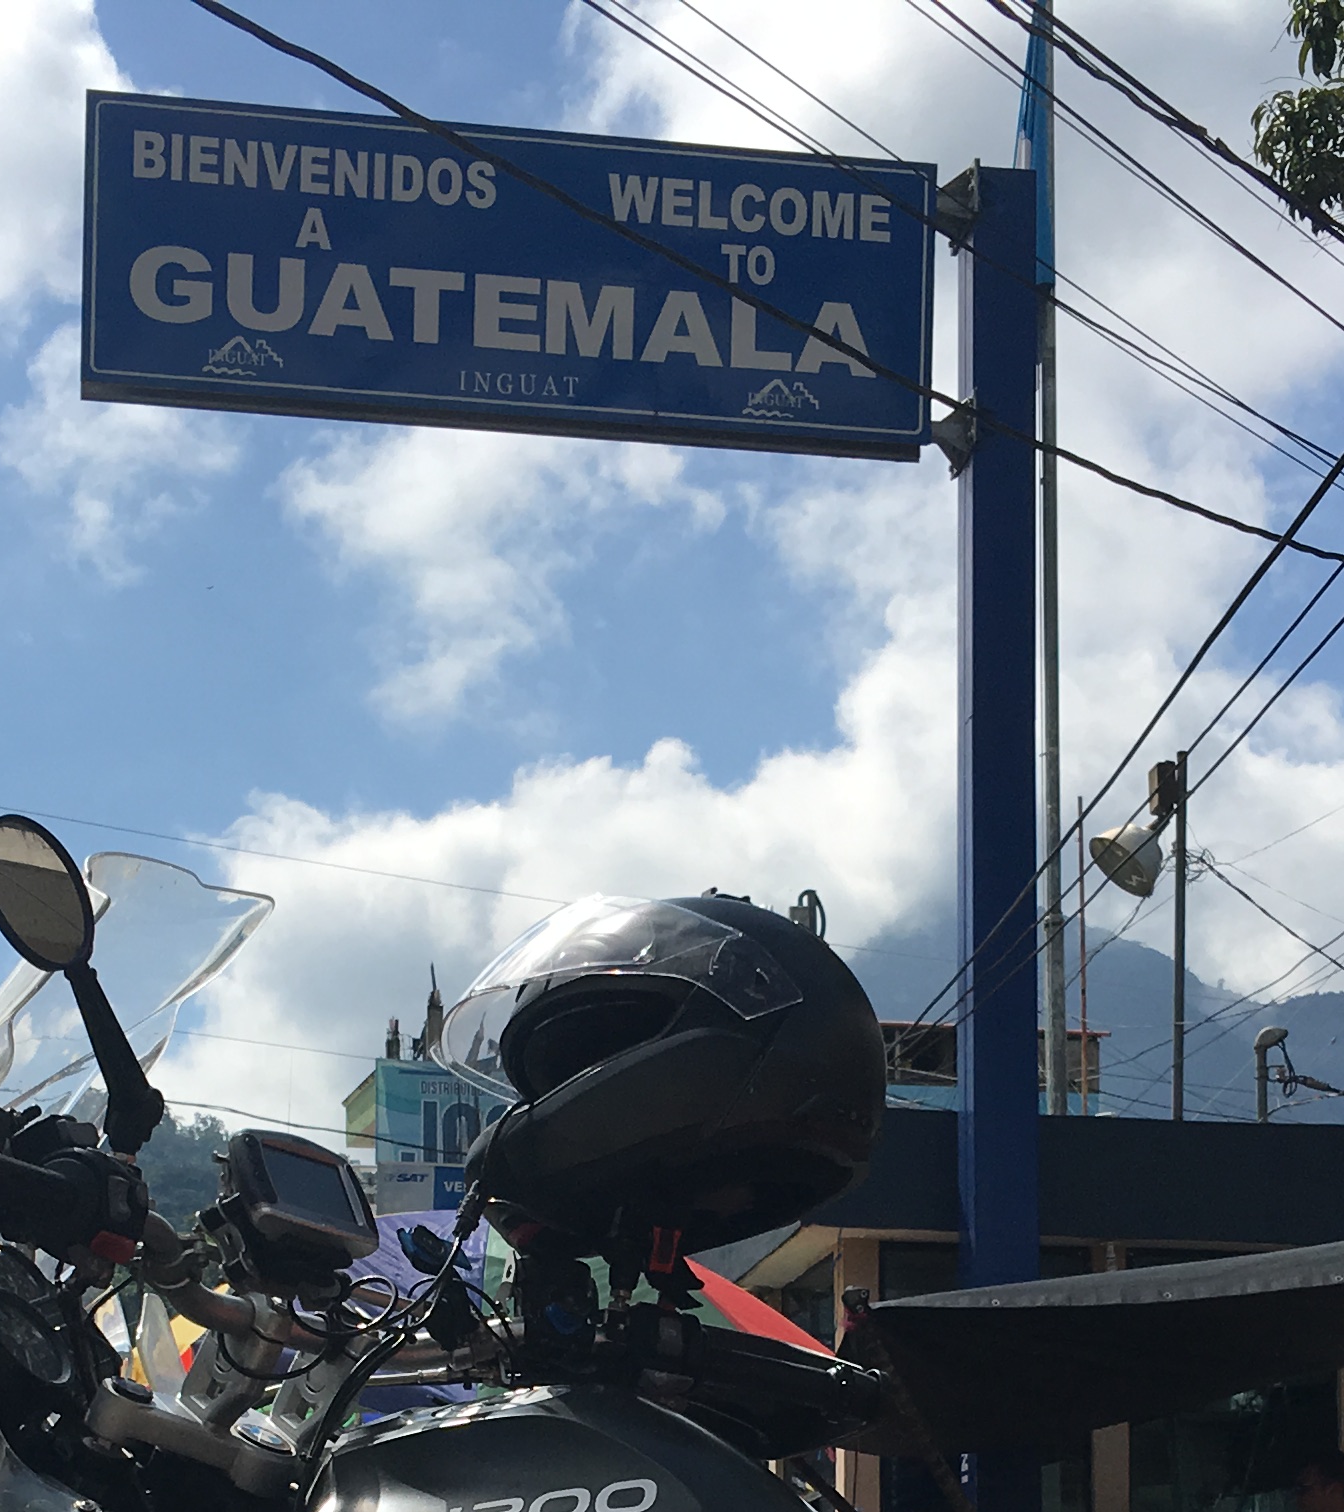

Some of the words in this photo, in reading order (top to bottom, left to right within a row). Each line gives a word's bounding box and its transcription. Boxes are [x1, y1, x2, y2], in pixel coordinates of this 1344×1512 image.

[132, 129, 497, 209] BIENVENIDOS
[295, 207, 332, 251] A
[608, 173, 892, 243] WELCOME
[720, 243, 776, 286] TO
[129, 245, 877, 379] GUATEMALA
[459, 369, 580, 398] INGUAT
[397, 1173, 428, 1183] SAT
